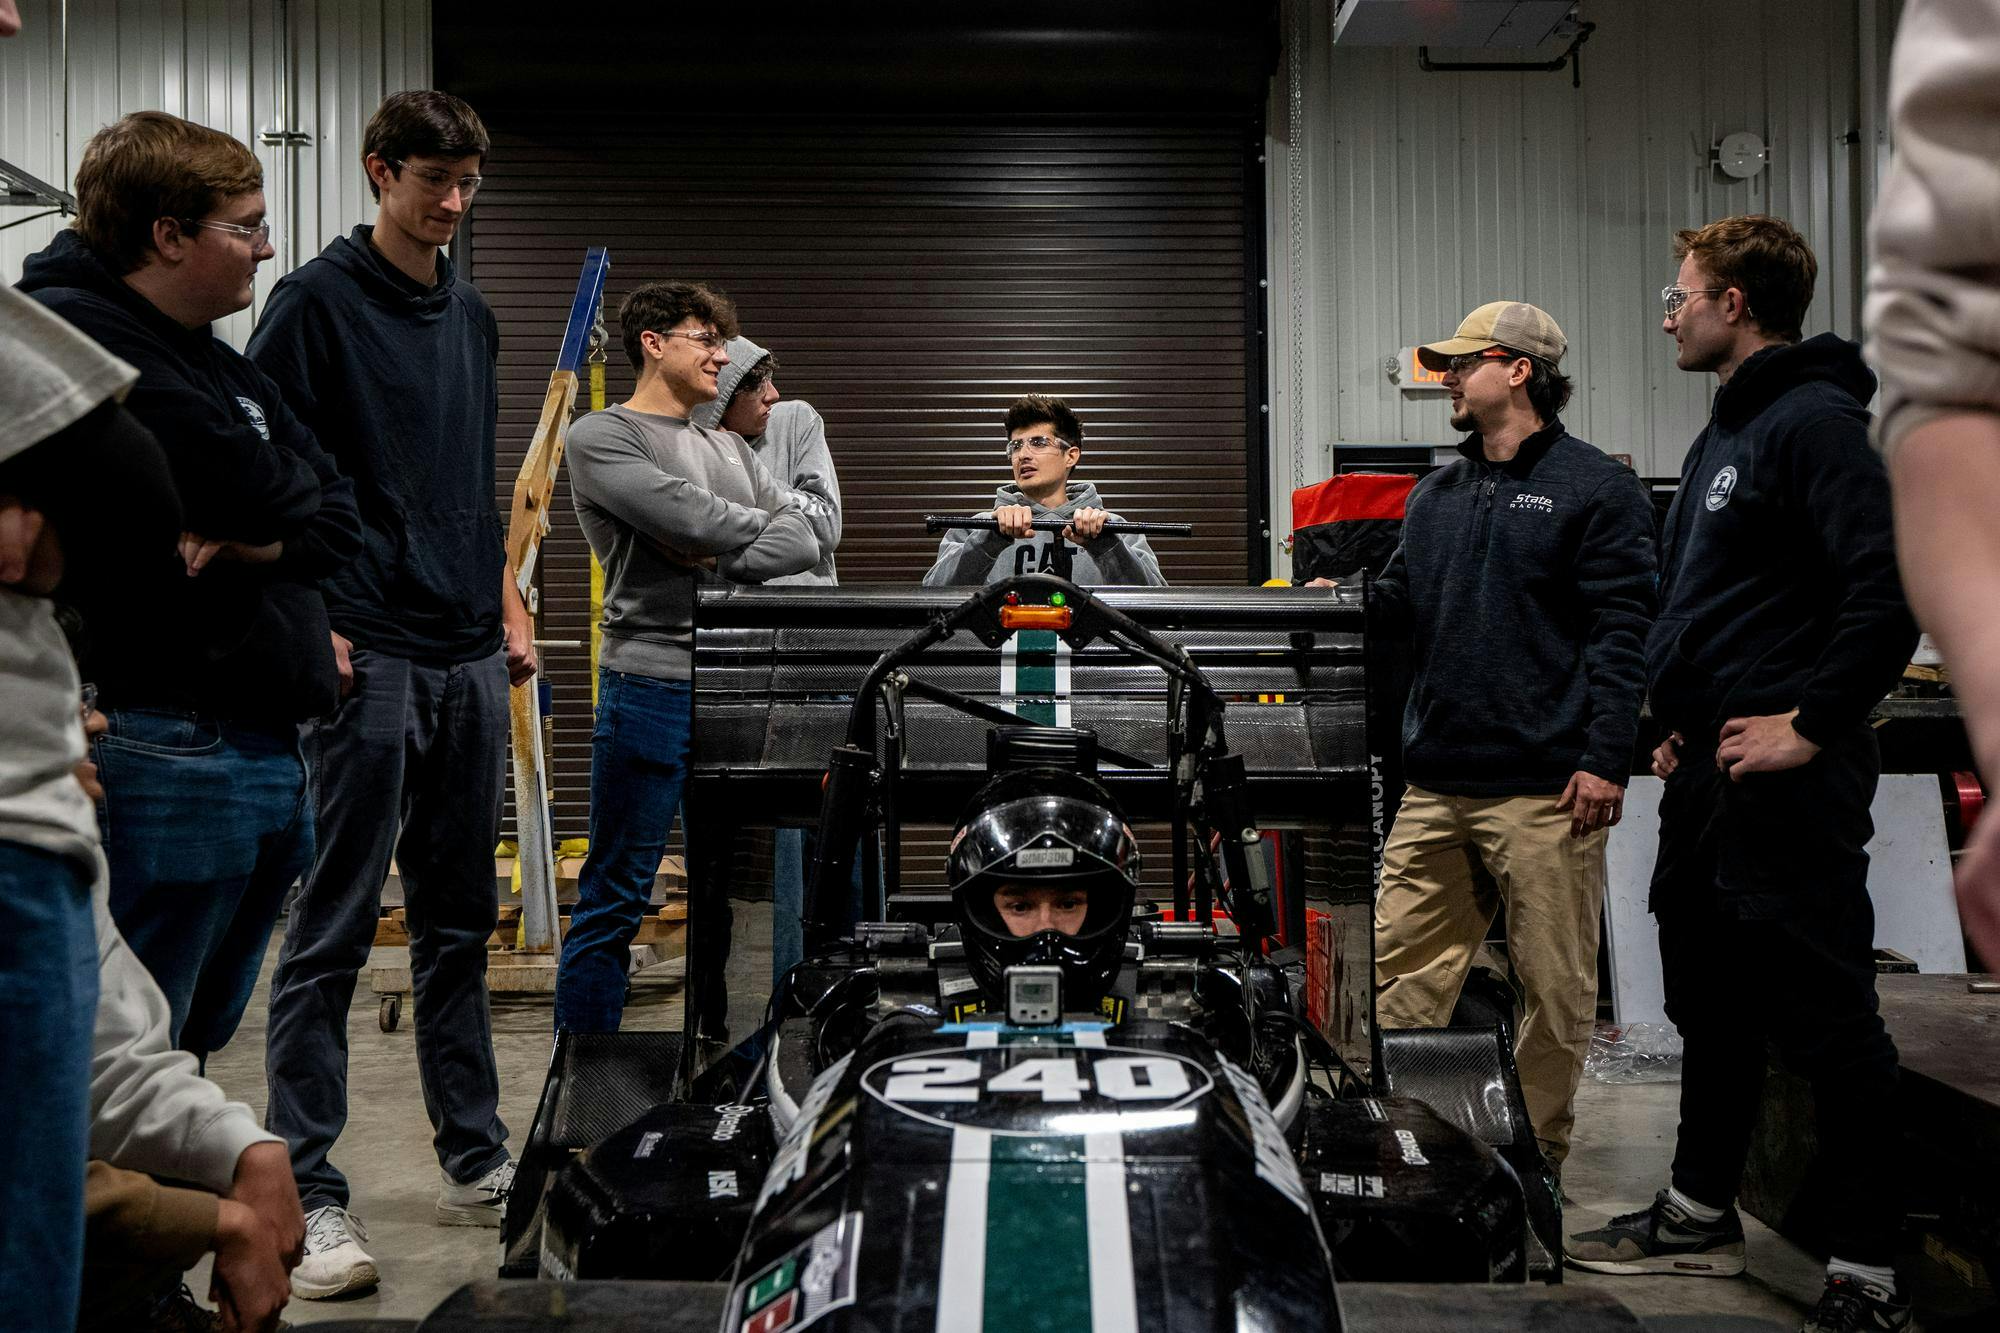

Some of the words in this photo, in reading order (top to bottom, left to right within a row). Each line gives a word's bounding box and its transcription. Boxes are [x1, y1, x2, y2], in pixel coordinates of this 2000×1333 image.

[1509, 503, 1552, 513] RACING
[1512, 493, 1553, 508] State
[1014, 542, 1078, 582] CAT
[884, 1057, 1191, 1102] 240
[711, 1112, 748, 1141] brembo
[707, 1170, 739, 1199] NSK
